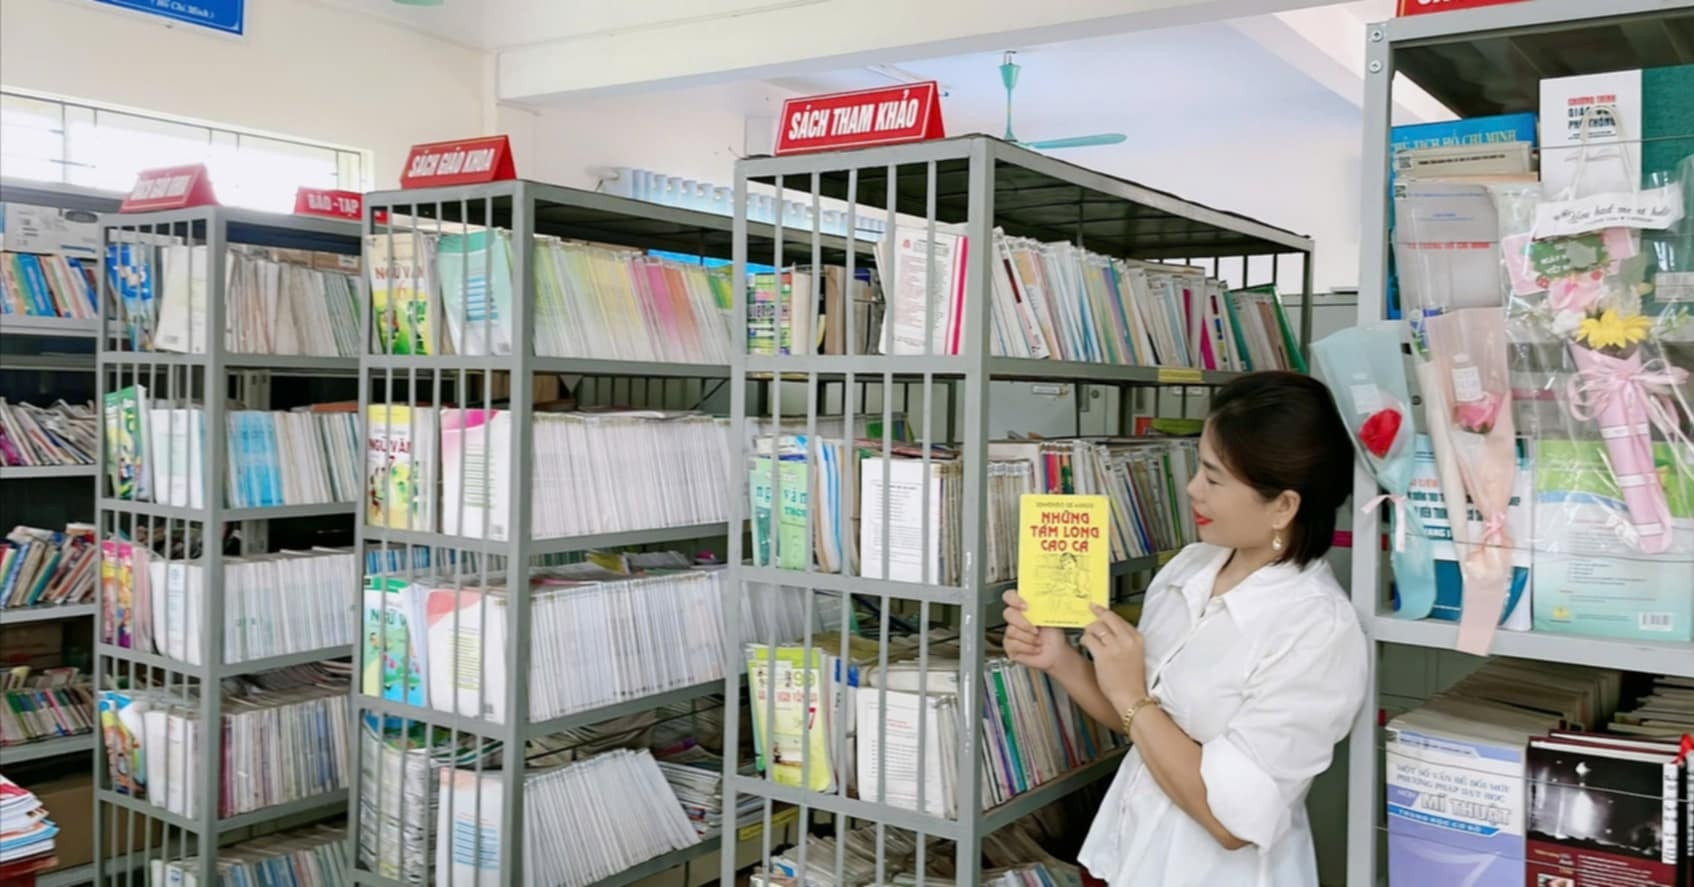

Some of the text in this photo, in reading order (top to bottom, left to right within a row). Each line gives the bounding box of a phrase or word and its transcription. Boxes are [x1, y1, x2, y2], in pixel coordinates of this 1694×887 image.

[788, 89, 919, 140] SÁCH THAM KHẢO
[1487, 129, 1517, 143] MINH
[407, 145, 496, 178] SÁCH GIÁO KHOA
[1041, 509, 1090, 524] NHỮNG
[1040, 539, 1067, 552] CAO
